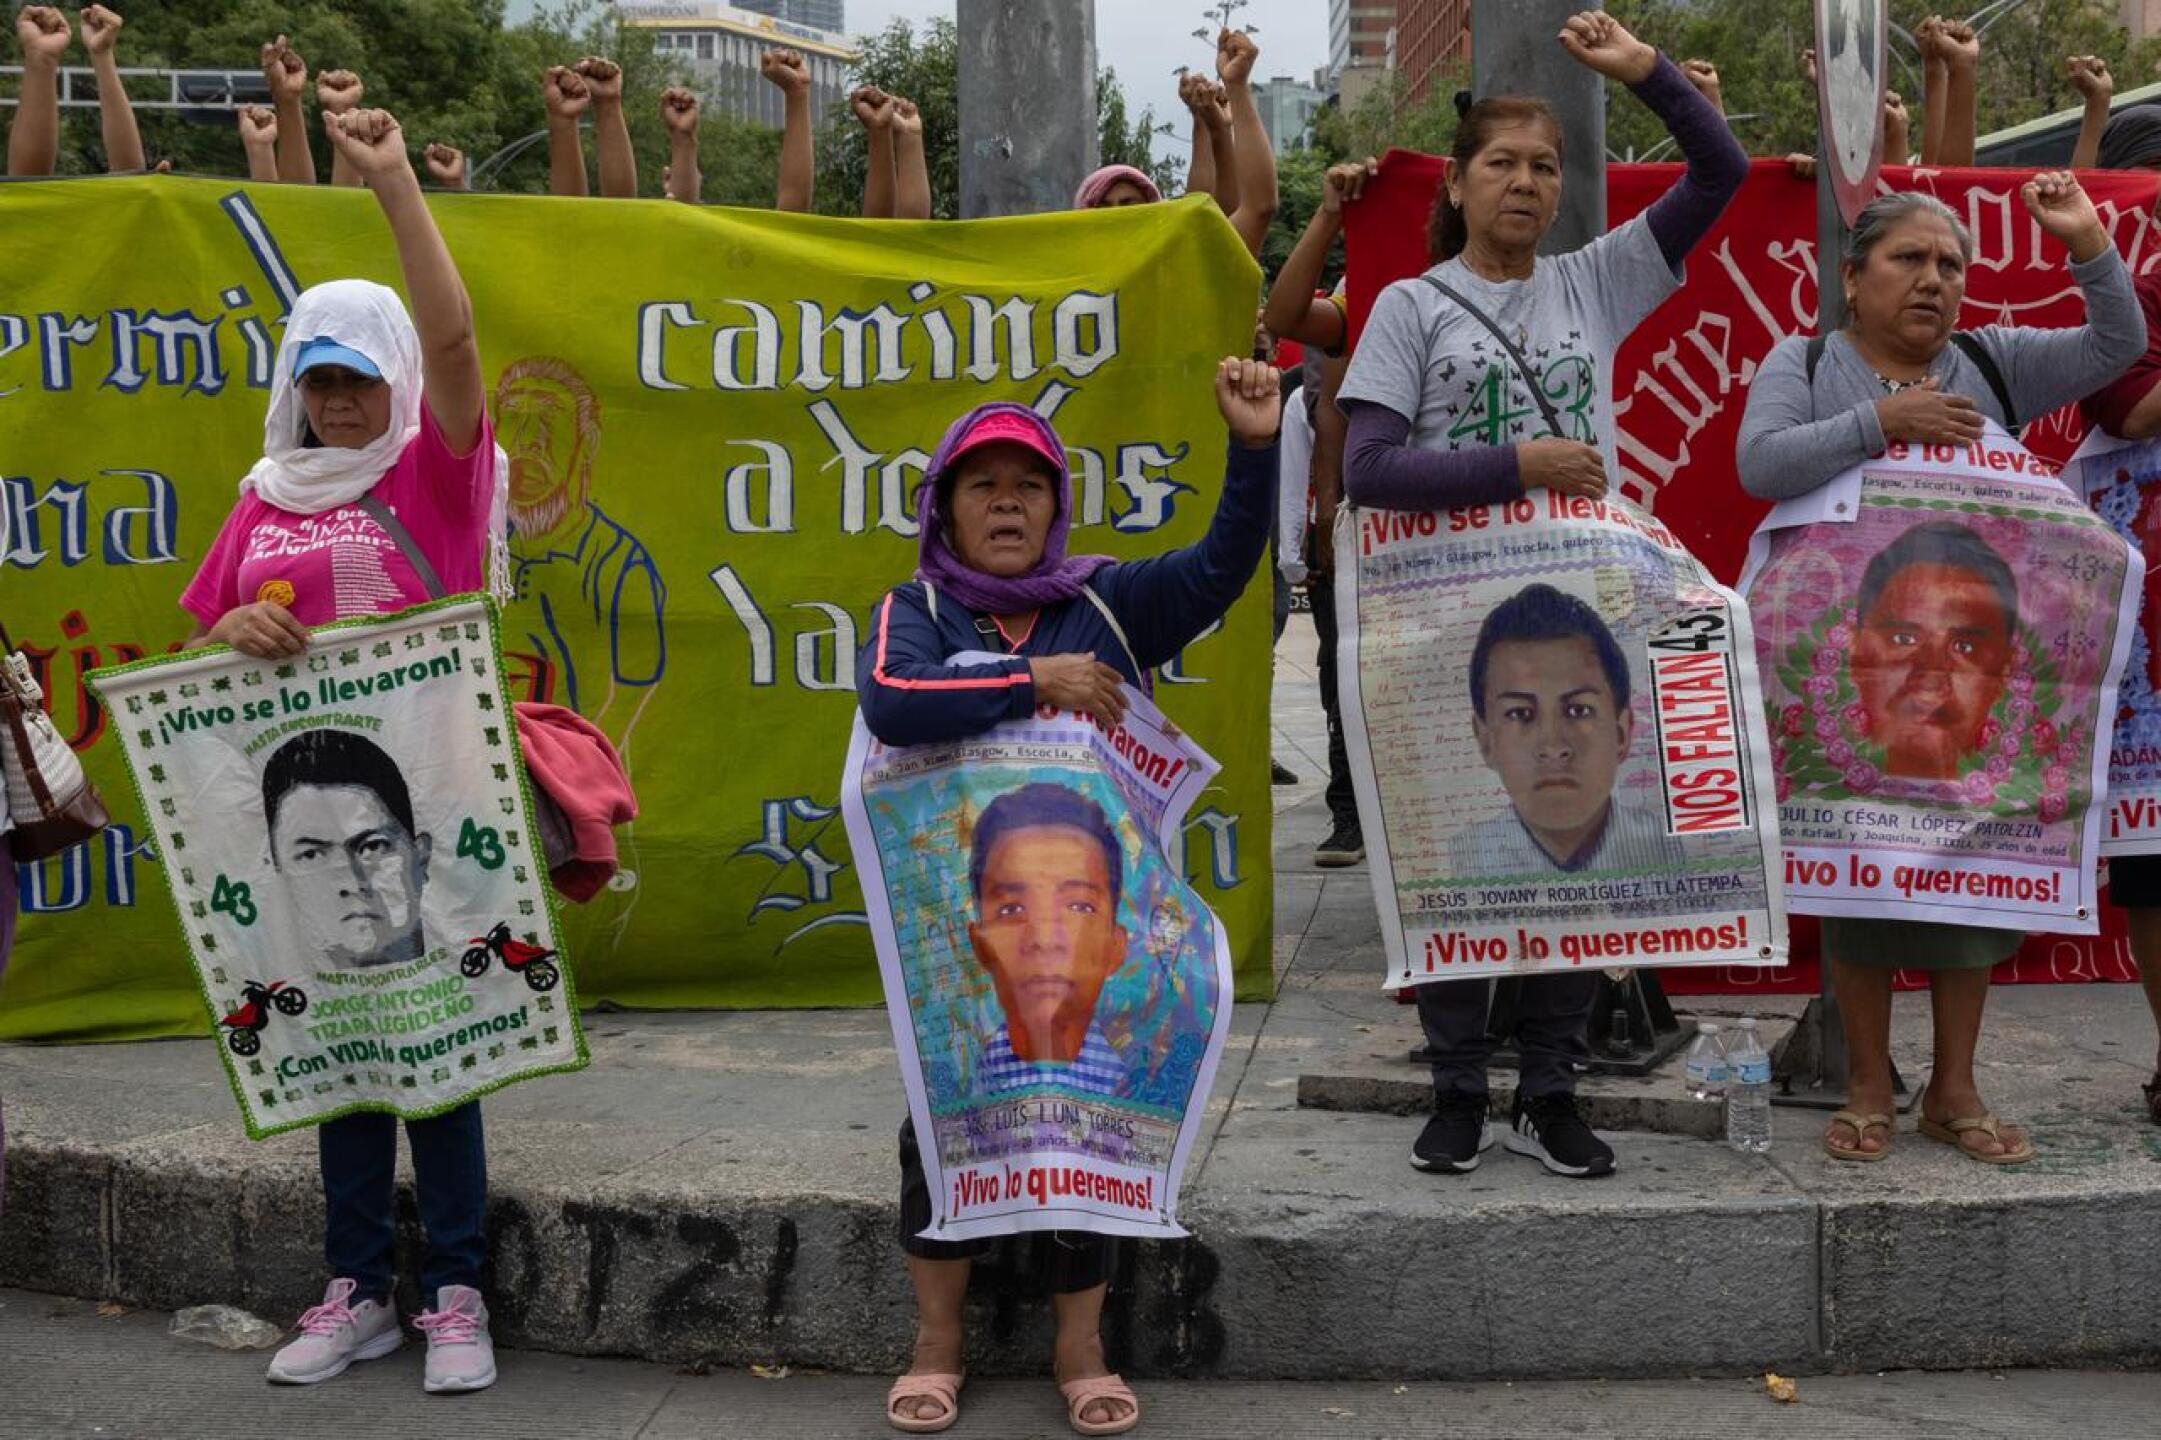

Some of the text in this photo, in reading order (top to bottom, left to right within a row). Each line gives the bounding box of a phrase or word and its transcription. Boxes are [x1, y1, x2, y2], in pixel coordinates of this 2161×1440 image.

[1447, 355, 1594, 447] 43
[1863, 475, 1906, 489] lasgow,
[1362, 504, 1437, 556] ¡Vivo
[1448, 502, 1490, 532] se
[1503, 496, 1535, 525] lo
[158, 647, 463, 745] ¡Vivo se lo llevaron!
[1657, 651, 1735, 763] FALTAN
[1669, 767, 1743, 833] NOS
[1780, 806, 1834, 823] JULIO
[1844, 808, 1899, 829] CÉSAR
[1911, 813, 1966, 836] LÓPEZ
[2110, 797, 2161, 838] ¡Vi
[456, 817, 506, 870] 43
[210, 873, 258, 927] 43
[1478, 888, 1538, 908] JOVANY
[1547, 881, 1642, 903] RODRÍGUEZ
[1654, 873, 1744, 897] TLATEMPA
[1781, 851, 2061, 904] ivo lo queremos!
[1425, 914, 1748, 972] ¡Vivo lo queremos!
[274, 1051, 329, 1086] ¡Con
[327, 1039, 382, 1066] VIDA
[399, 1005, 529, 1070] queremos!
[953, 1163, 1153, 1217] ¡Vivo lo queremos!
